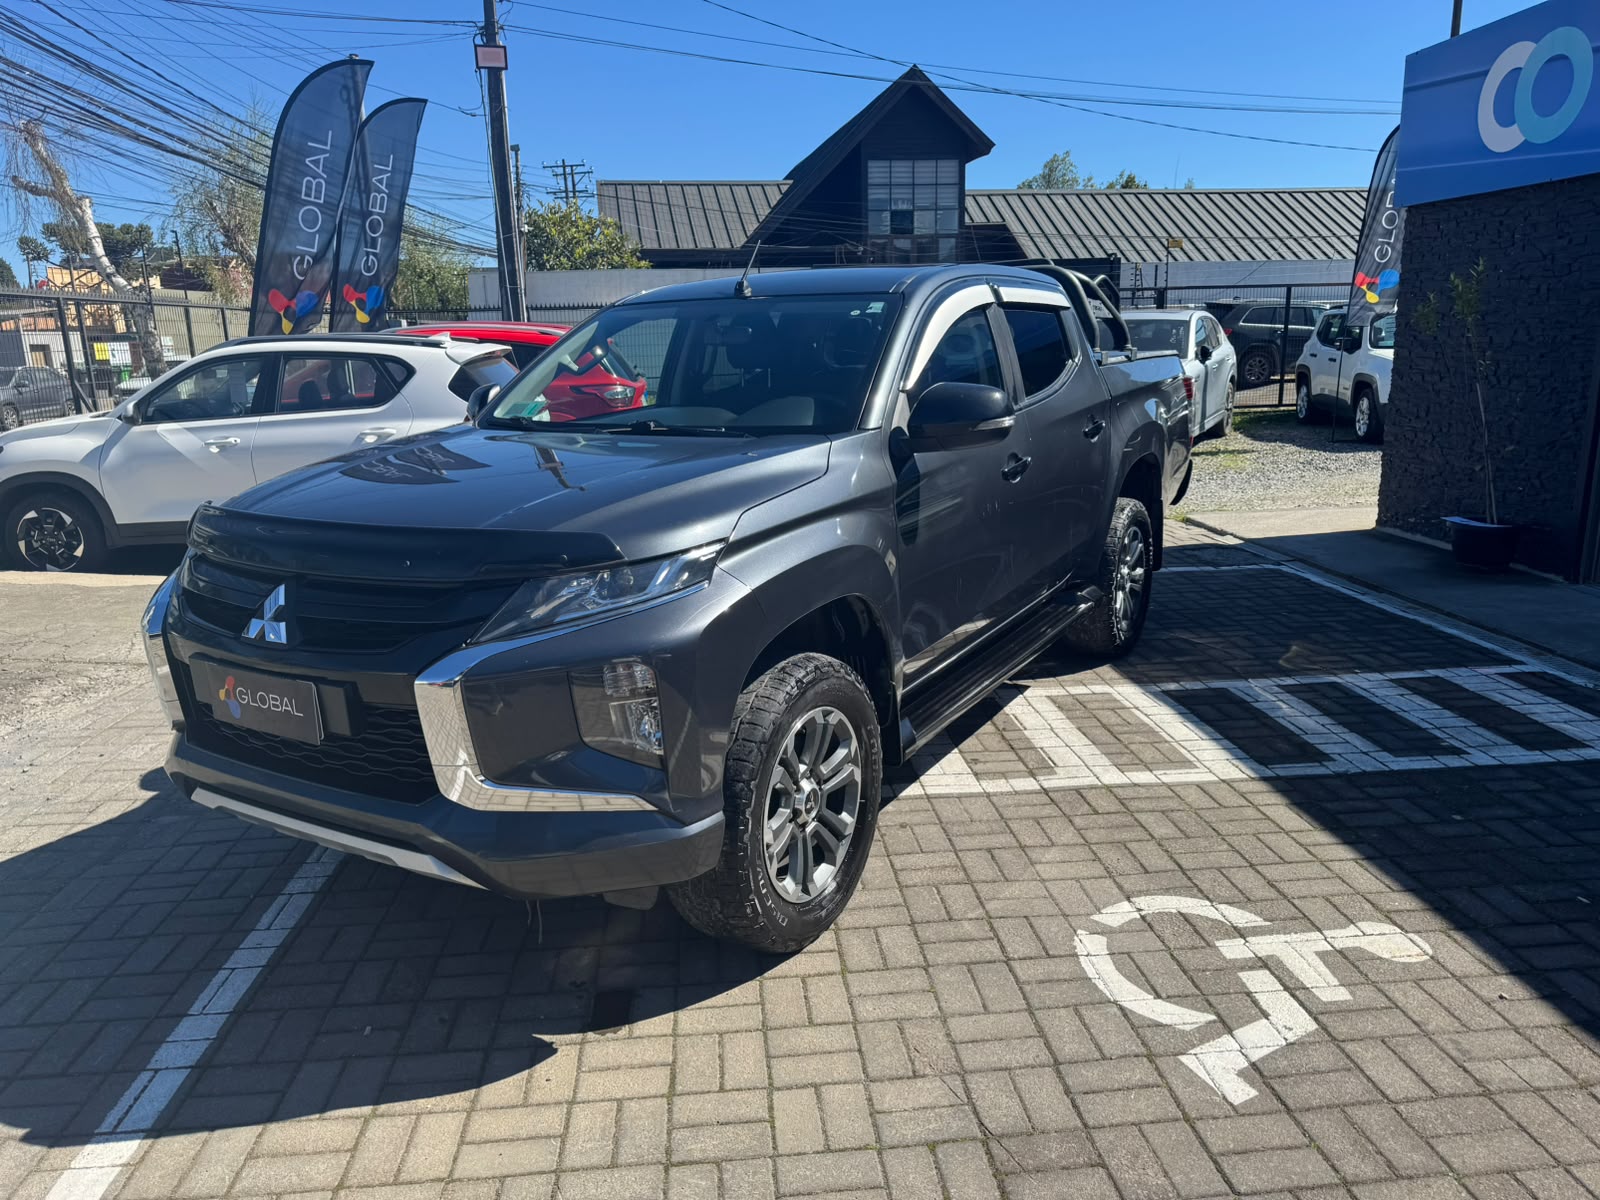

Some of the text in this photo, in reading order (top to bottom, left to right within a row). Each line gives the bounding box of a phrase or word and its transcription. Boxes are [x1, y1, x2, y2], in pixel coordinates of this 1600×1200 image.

[293, 130, 332, 280] GLOBAL
[361, 154, 393, 276] GLOBAL
[236, 687, 304, 717] GLOBAL
